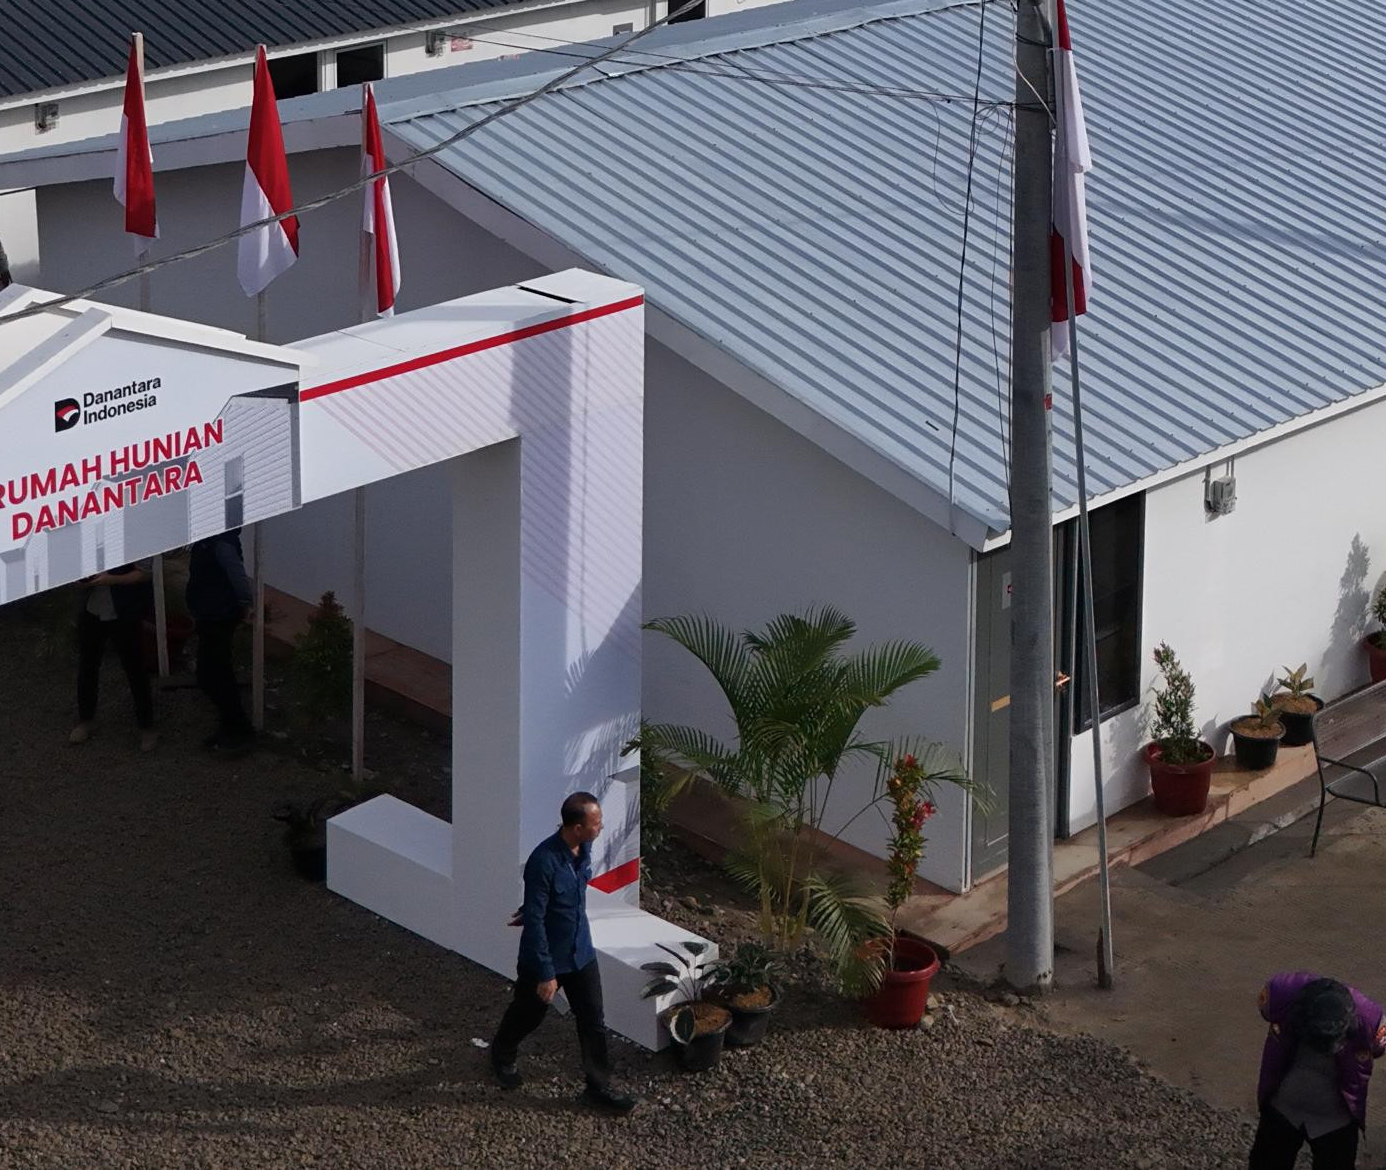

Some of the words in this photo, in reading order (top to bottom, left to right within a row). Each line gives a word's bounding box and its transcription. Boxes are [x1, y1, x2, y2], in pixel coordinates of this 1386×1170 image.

[83, 377, 161, 408] Danantara
[83, 394, 157, 425] Indonesia
[110, 418, 223, 477] HUNIAN
[12, 461, 204, 541] DANANTARA
